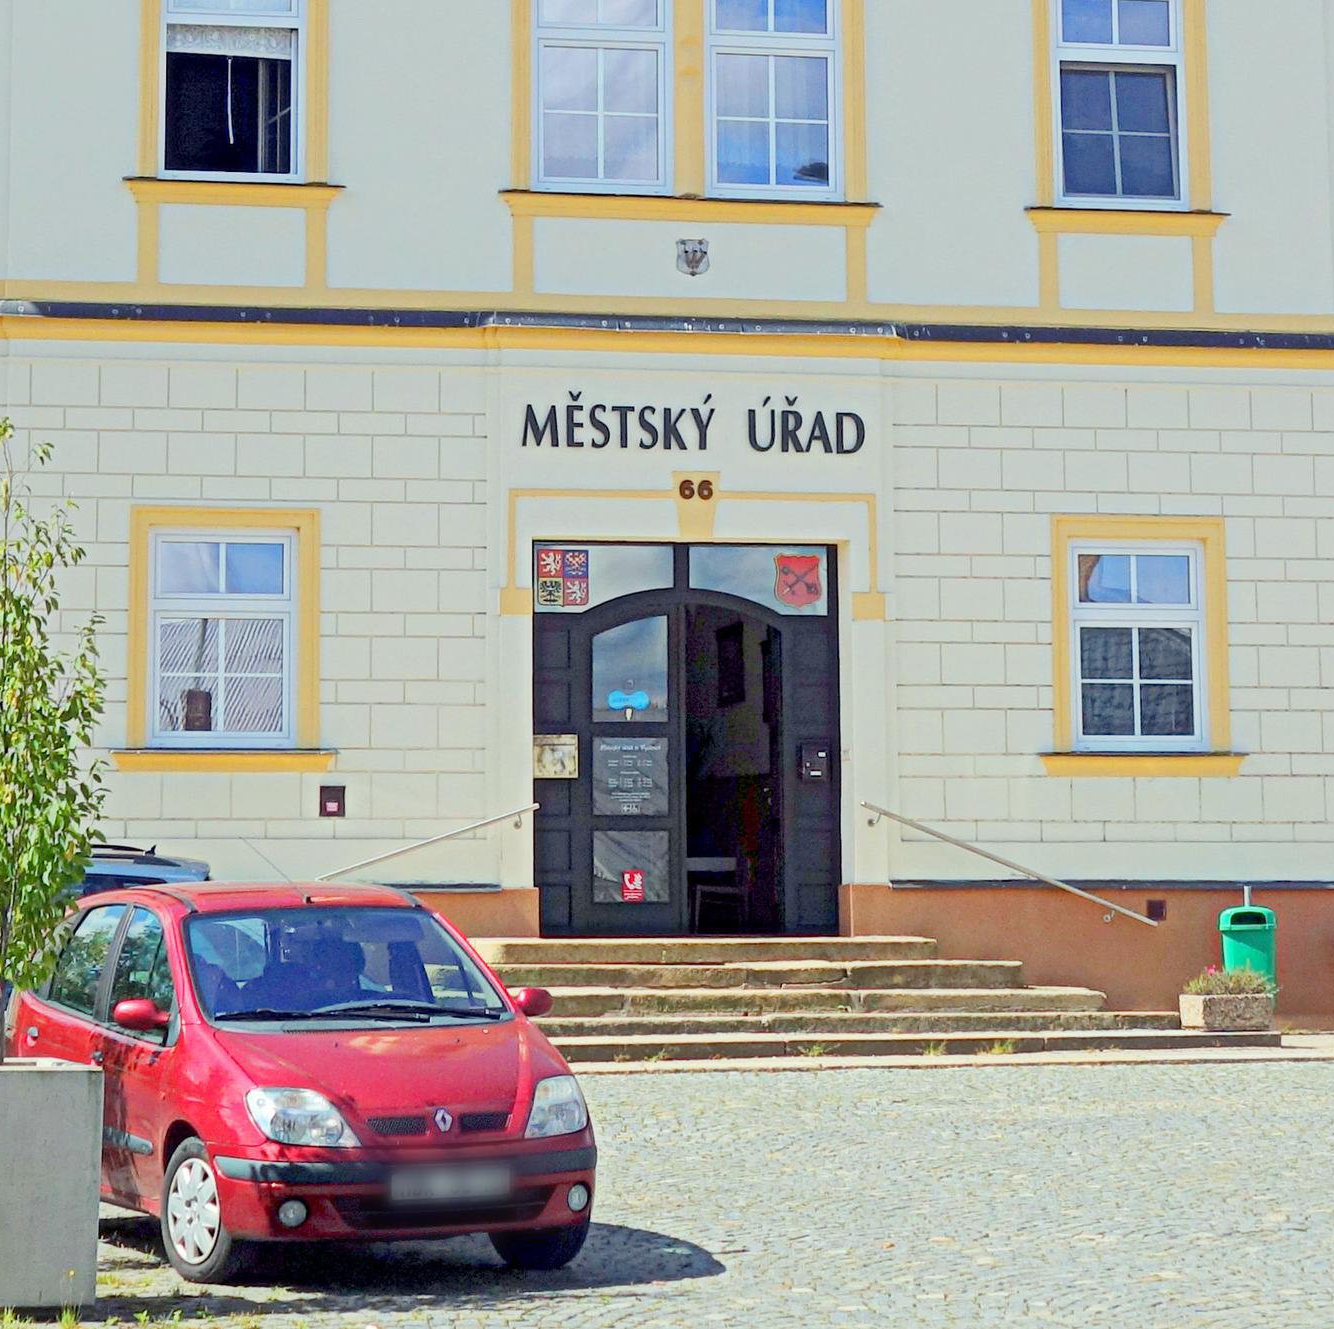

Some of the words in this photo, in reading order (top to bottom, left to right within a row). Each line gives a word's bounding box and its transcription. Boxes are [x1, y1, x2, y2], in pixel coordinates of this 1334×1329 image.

[521, 390, 716, 450] MĚSTSKÝ
[747, 396, 866, 455] ÚŘAD
[679, 479, 713, 500] 66
